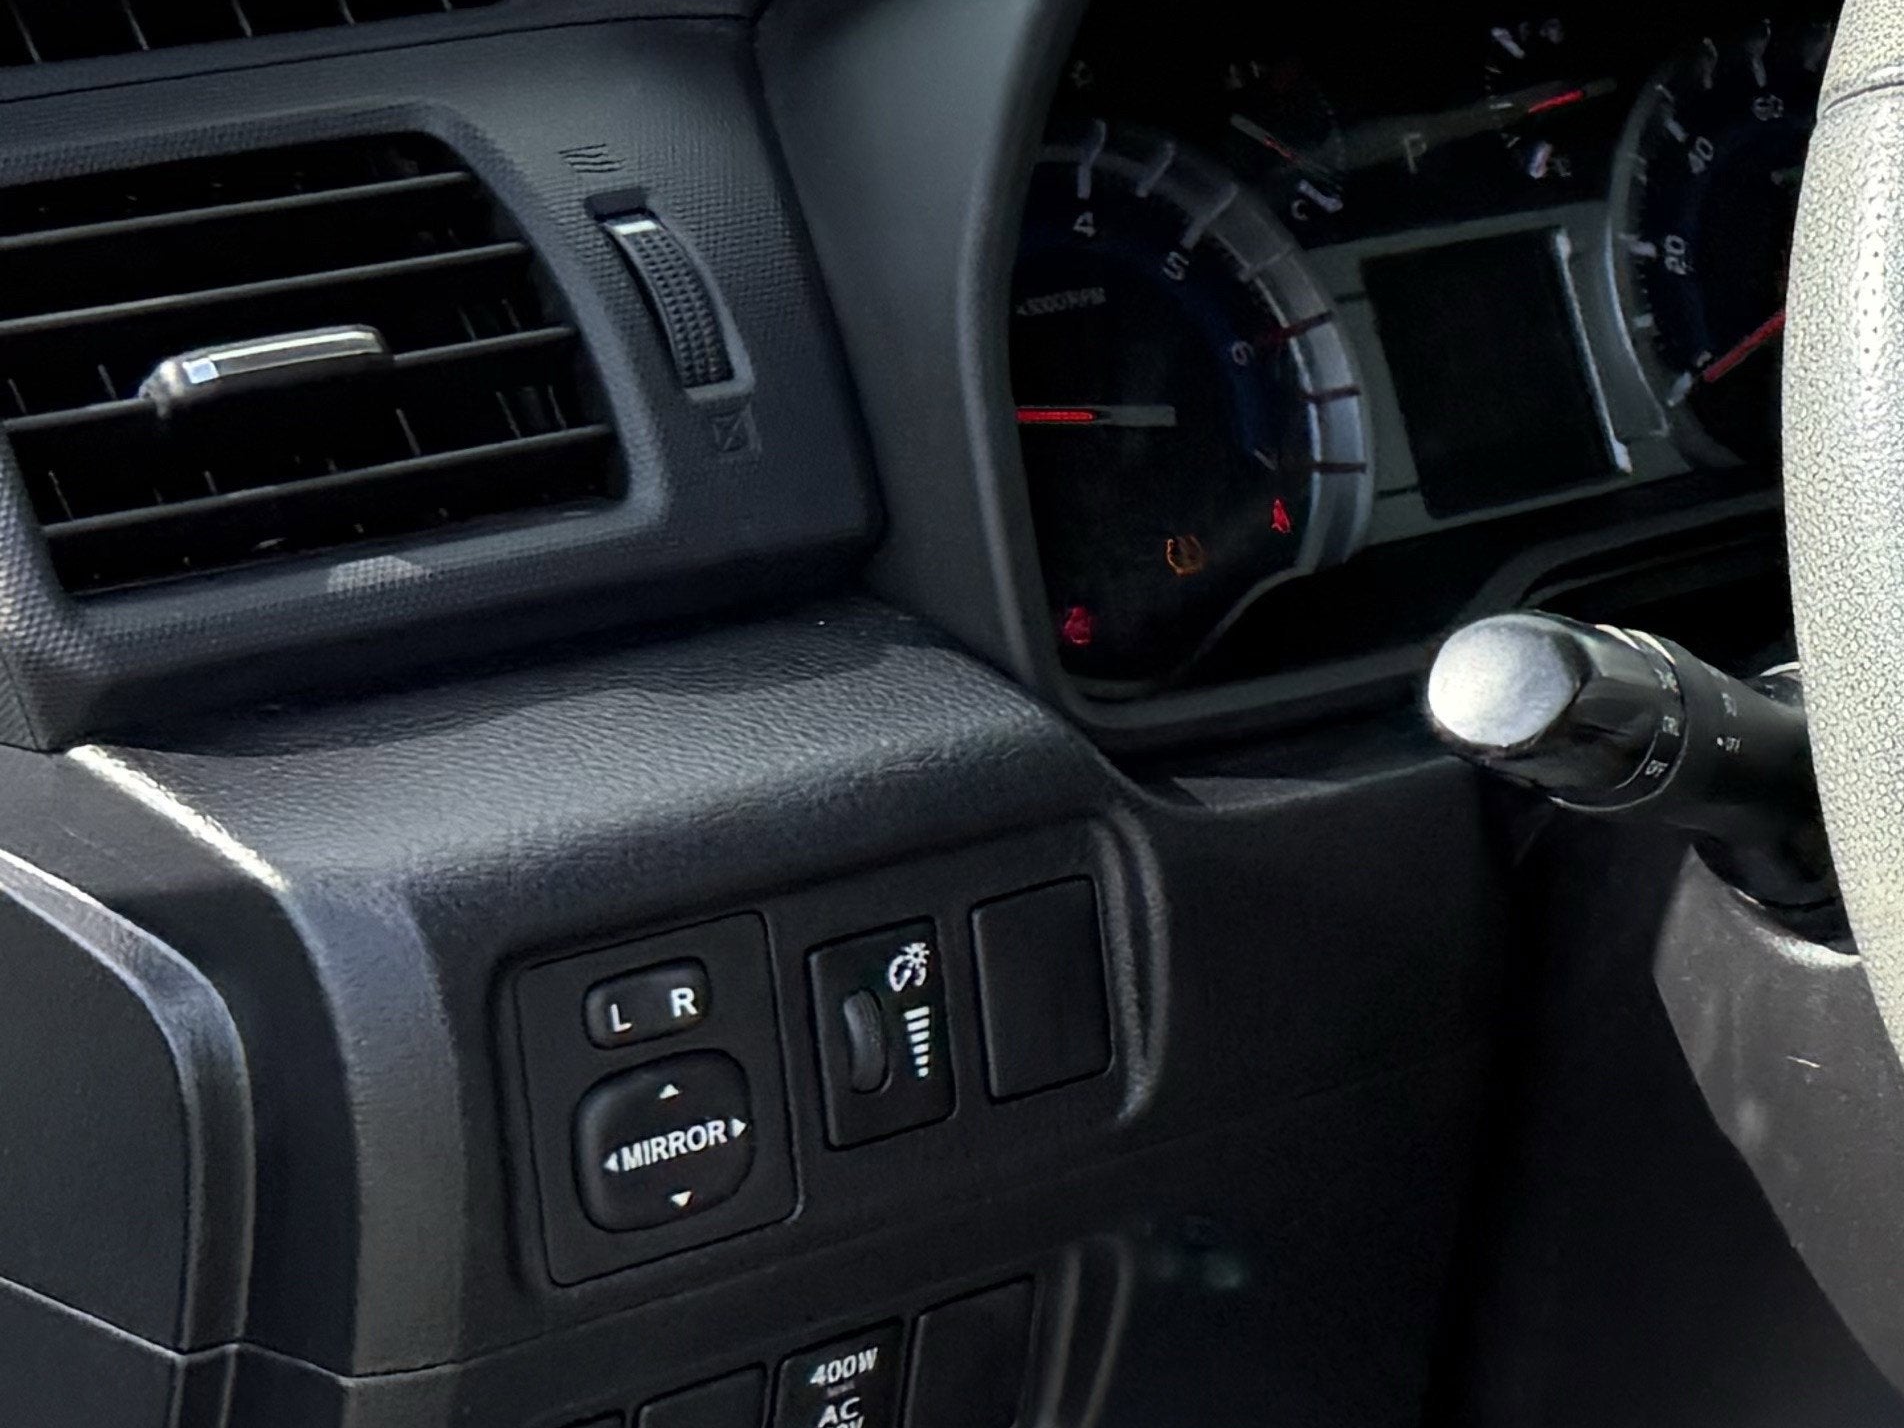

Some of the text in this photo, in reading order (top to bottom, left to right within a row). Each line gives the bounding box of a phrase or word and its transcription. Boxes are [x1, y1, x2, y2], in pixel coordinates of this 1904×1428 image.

[1073, 211, 1096, 238] 4
[1162, 250, 1190, 281] 5
[610, 987, 699, 1033] L R
[621, 1119, 729, 1172] MIRROR
[809, 1346, 879, 1388] 400W
[817, 1396, 861, 1428] AC
